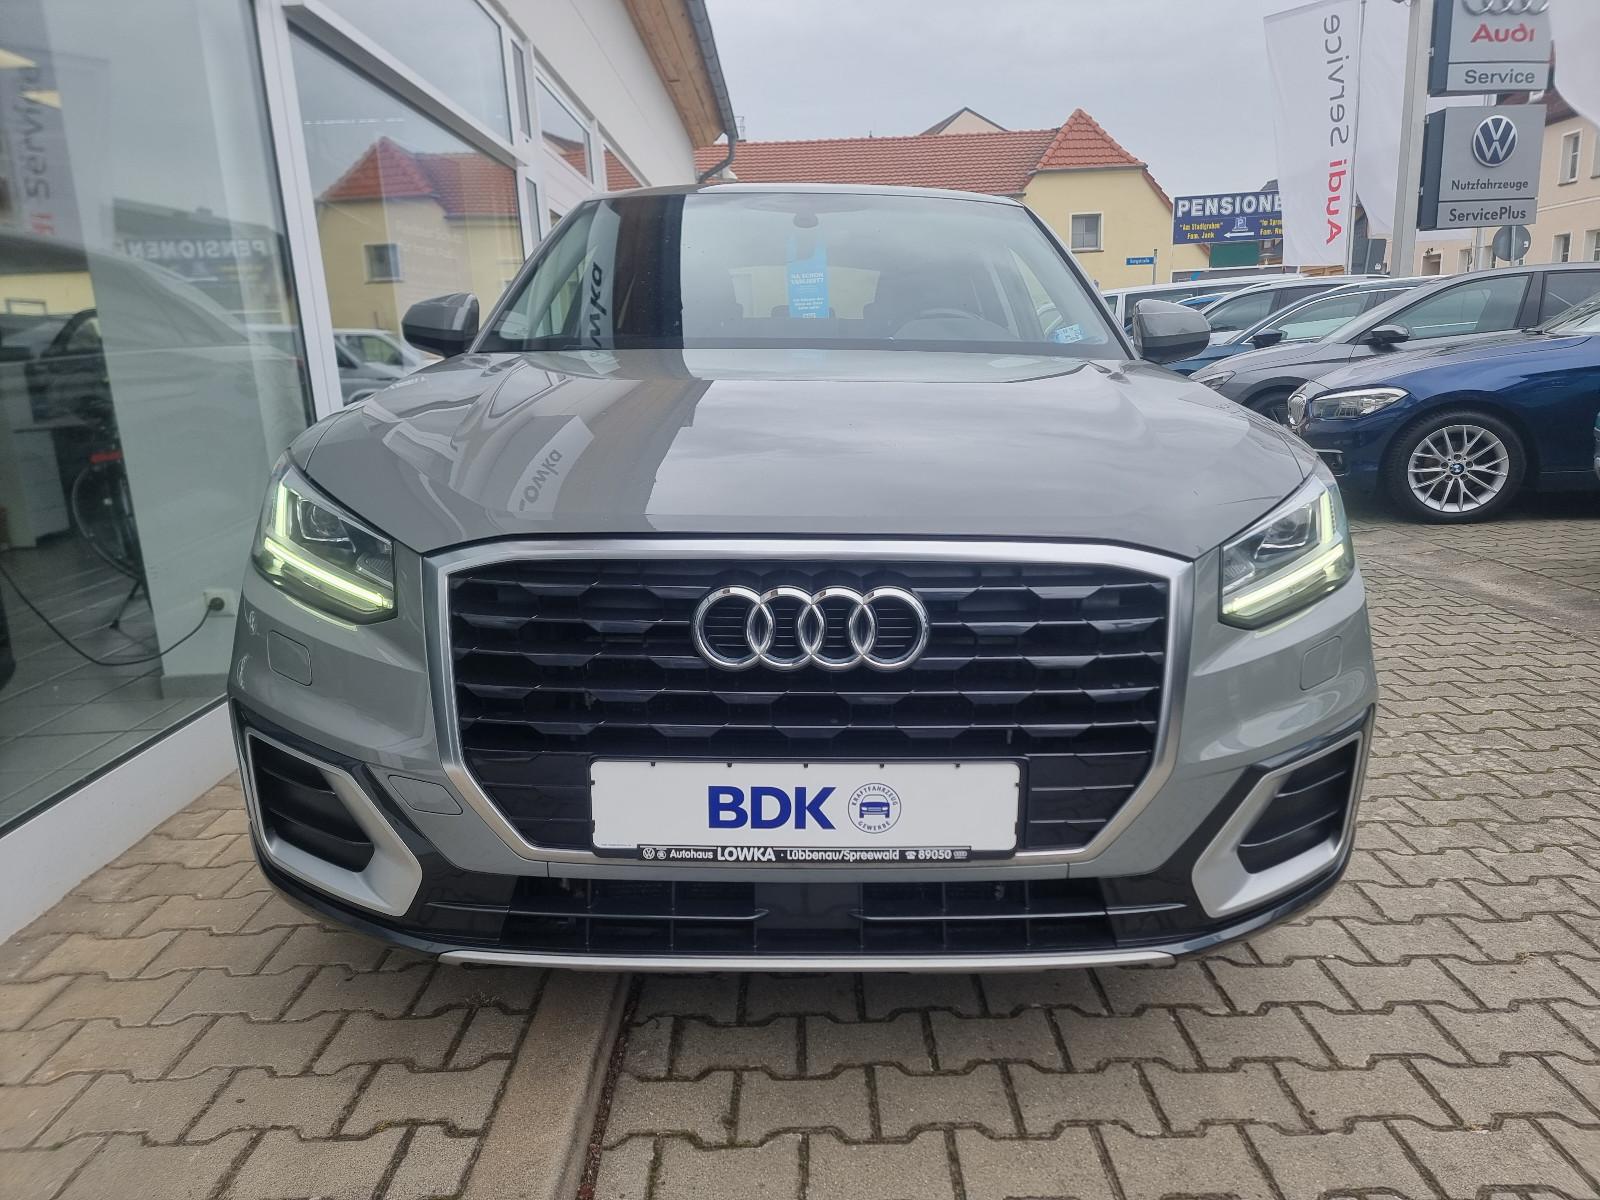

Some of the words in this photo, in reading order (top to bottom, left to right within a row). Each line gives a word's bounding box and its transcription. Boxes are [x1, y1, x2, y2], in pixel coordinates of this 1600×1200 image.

[1470, 23, 1536, 43] Audi
[1464, 68, 1535, 84] Service
[1451, 179, 1529, 191] Nutzfahrzeuge
[1449, 205, 1527, 222] ServicePlus
[851, 785, 898, 806] KRAFTFAHRZEUG
[708, 785, 836, 830] BDK
[858, 821, 891, 831] GEWERBE
[669, 848, 714, 860] Autohaus
[716, 846, 776, 862] LOWKA
[917, 849, 952, 860] 89050
